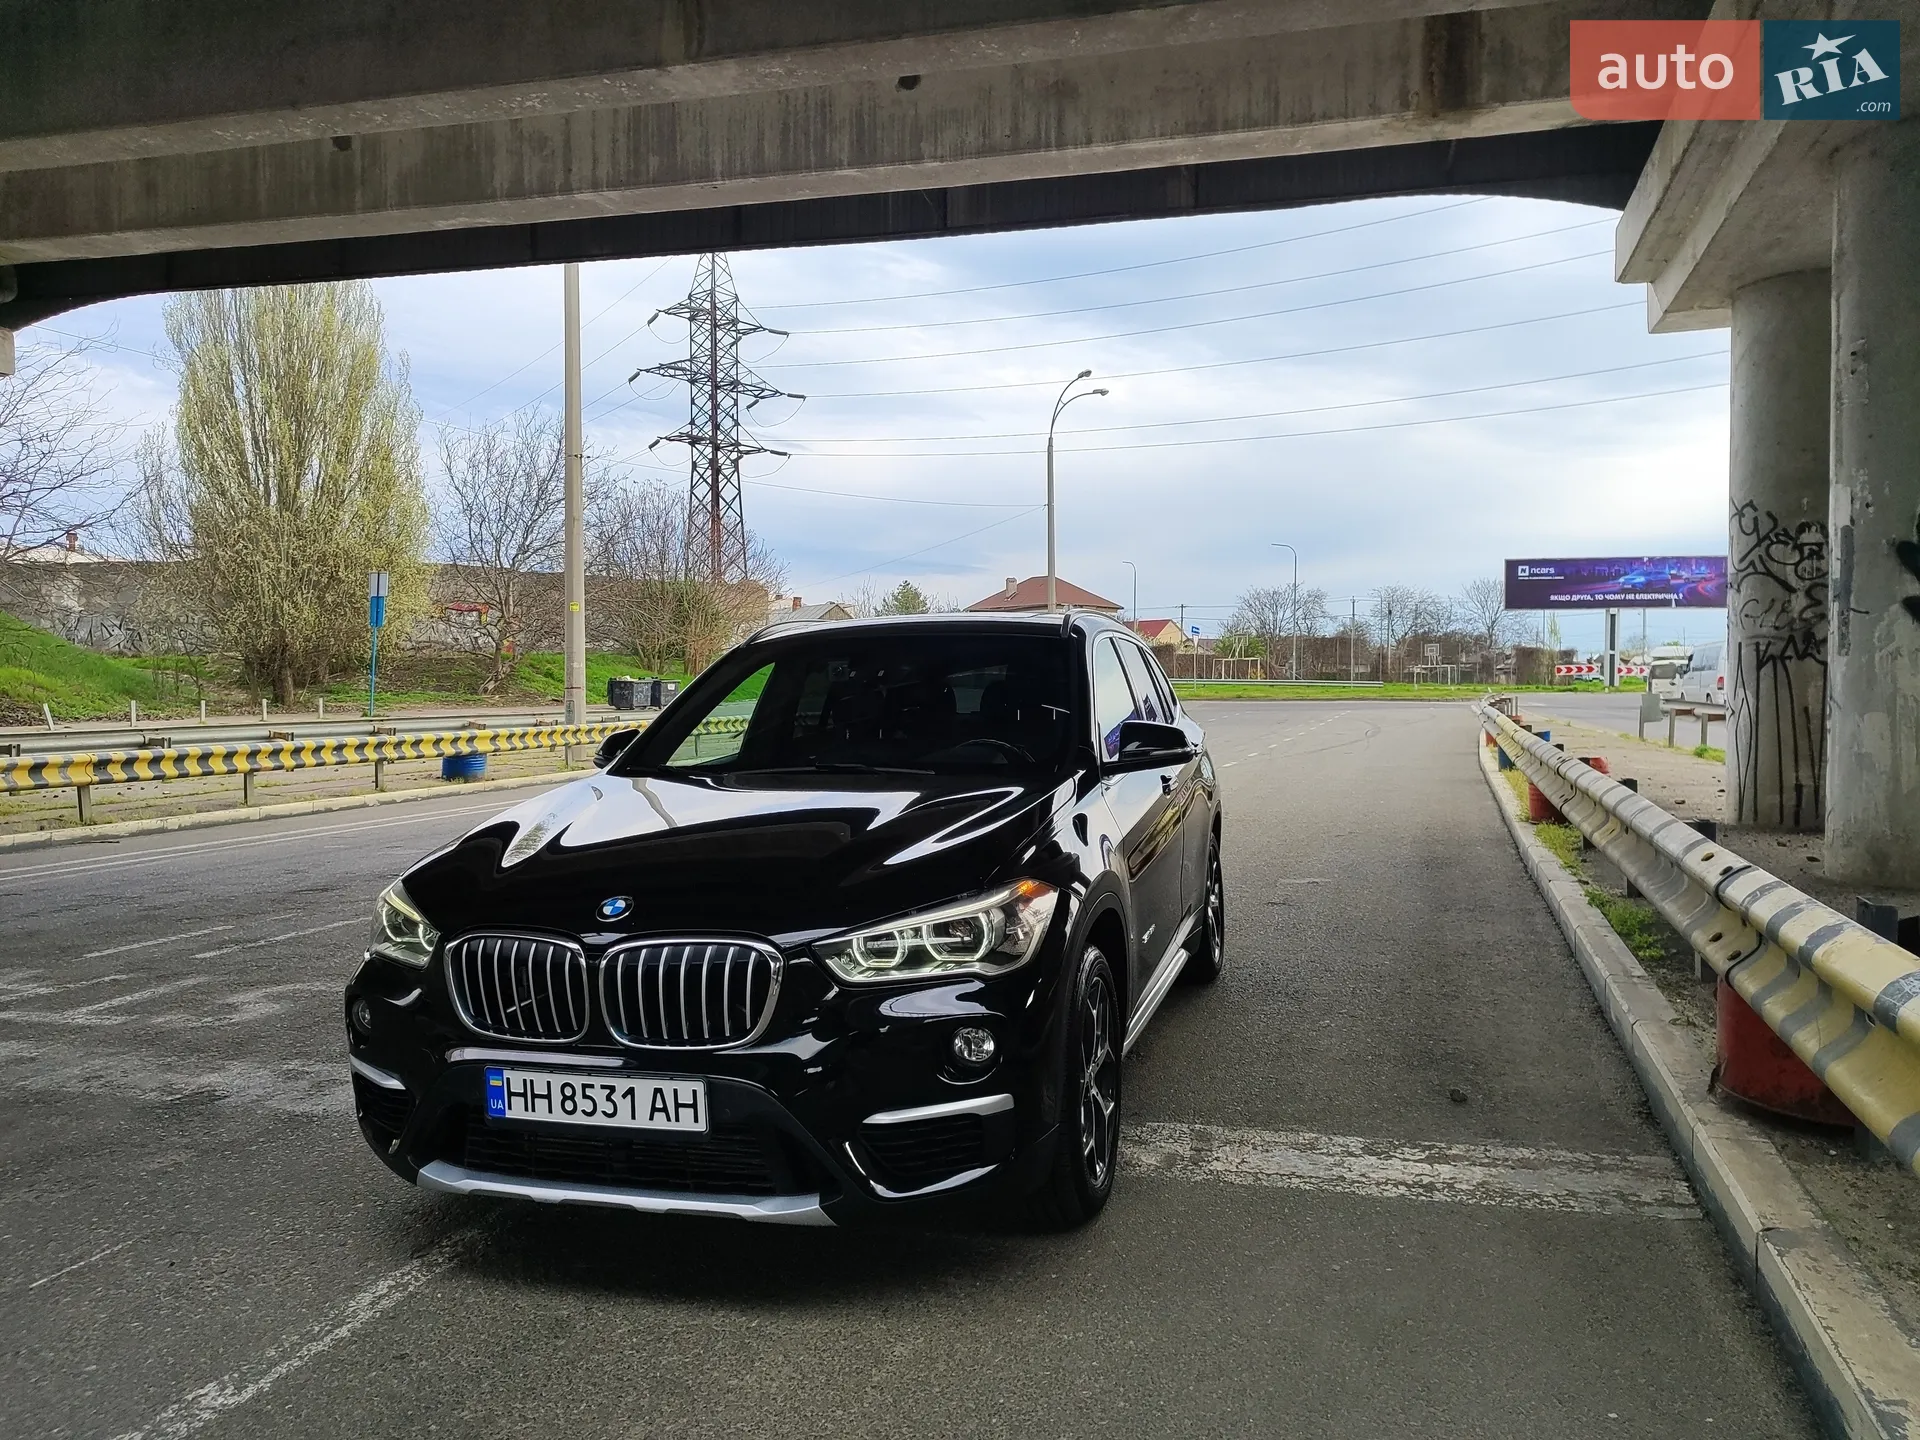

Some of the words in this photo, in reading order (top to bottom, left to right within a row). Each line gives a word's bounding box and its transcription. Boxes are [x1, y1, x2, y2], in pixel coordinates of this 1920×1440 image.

[1549, 594, 1571, 602] ЯКЩО
[1594, 593, 1604, 601] ТО
[490, 1097, 504, 1110] UA
[559, 1081, 637, 1120] 8531
